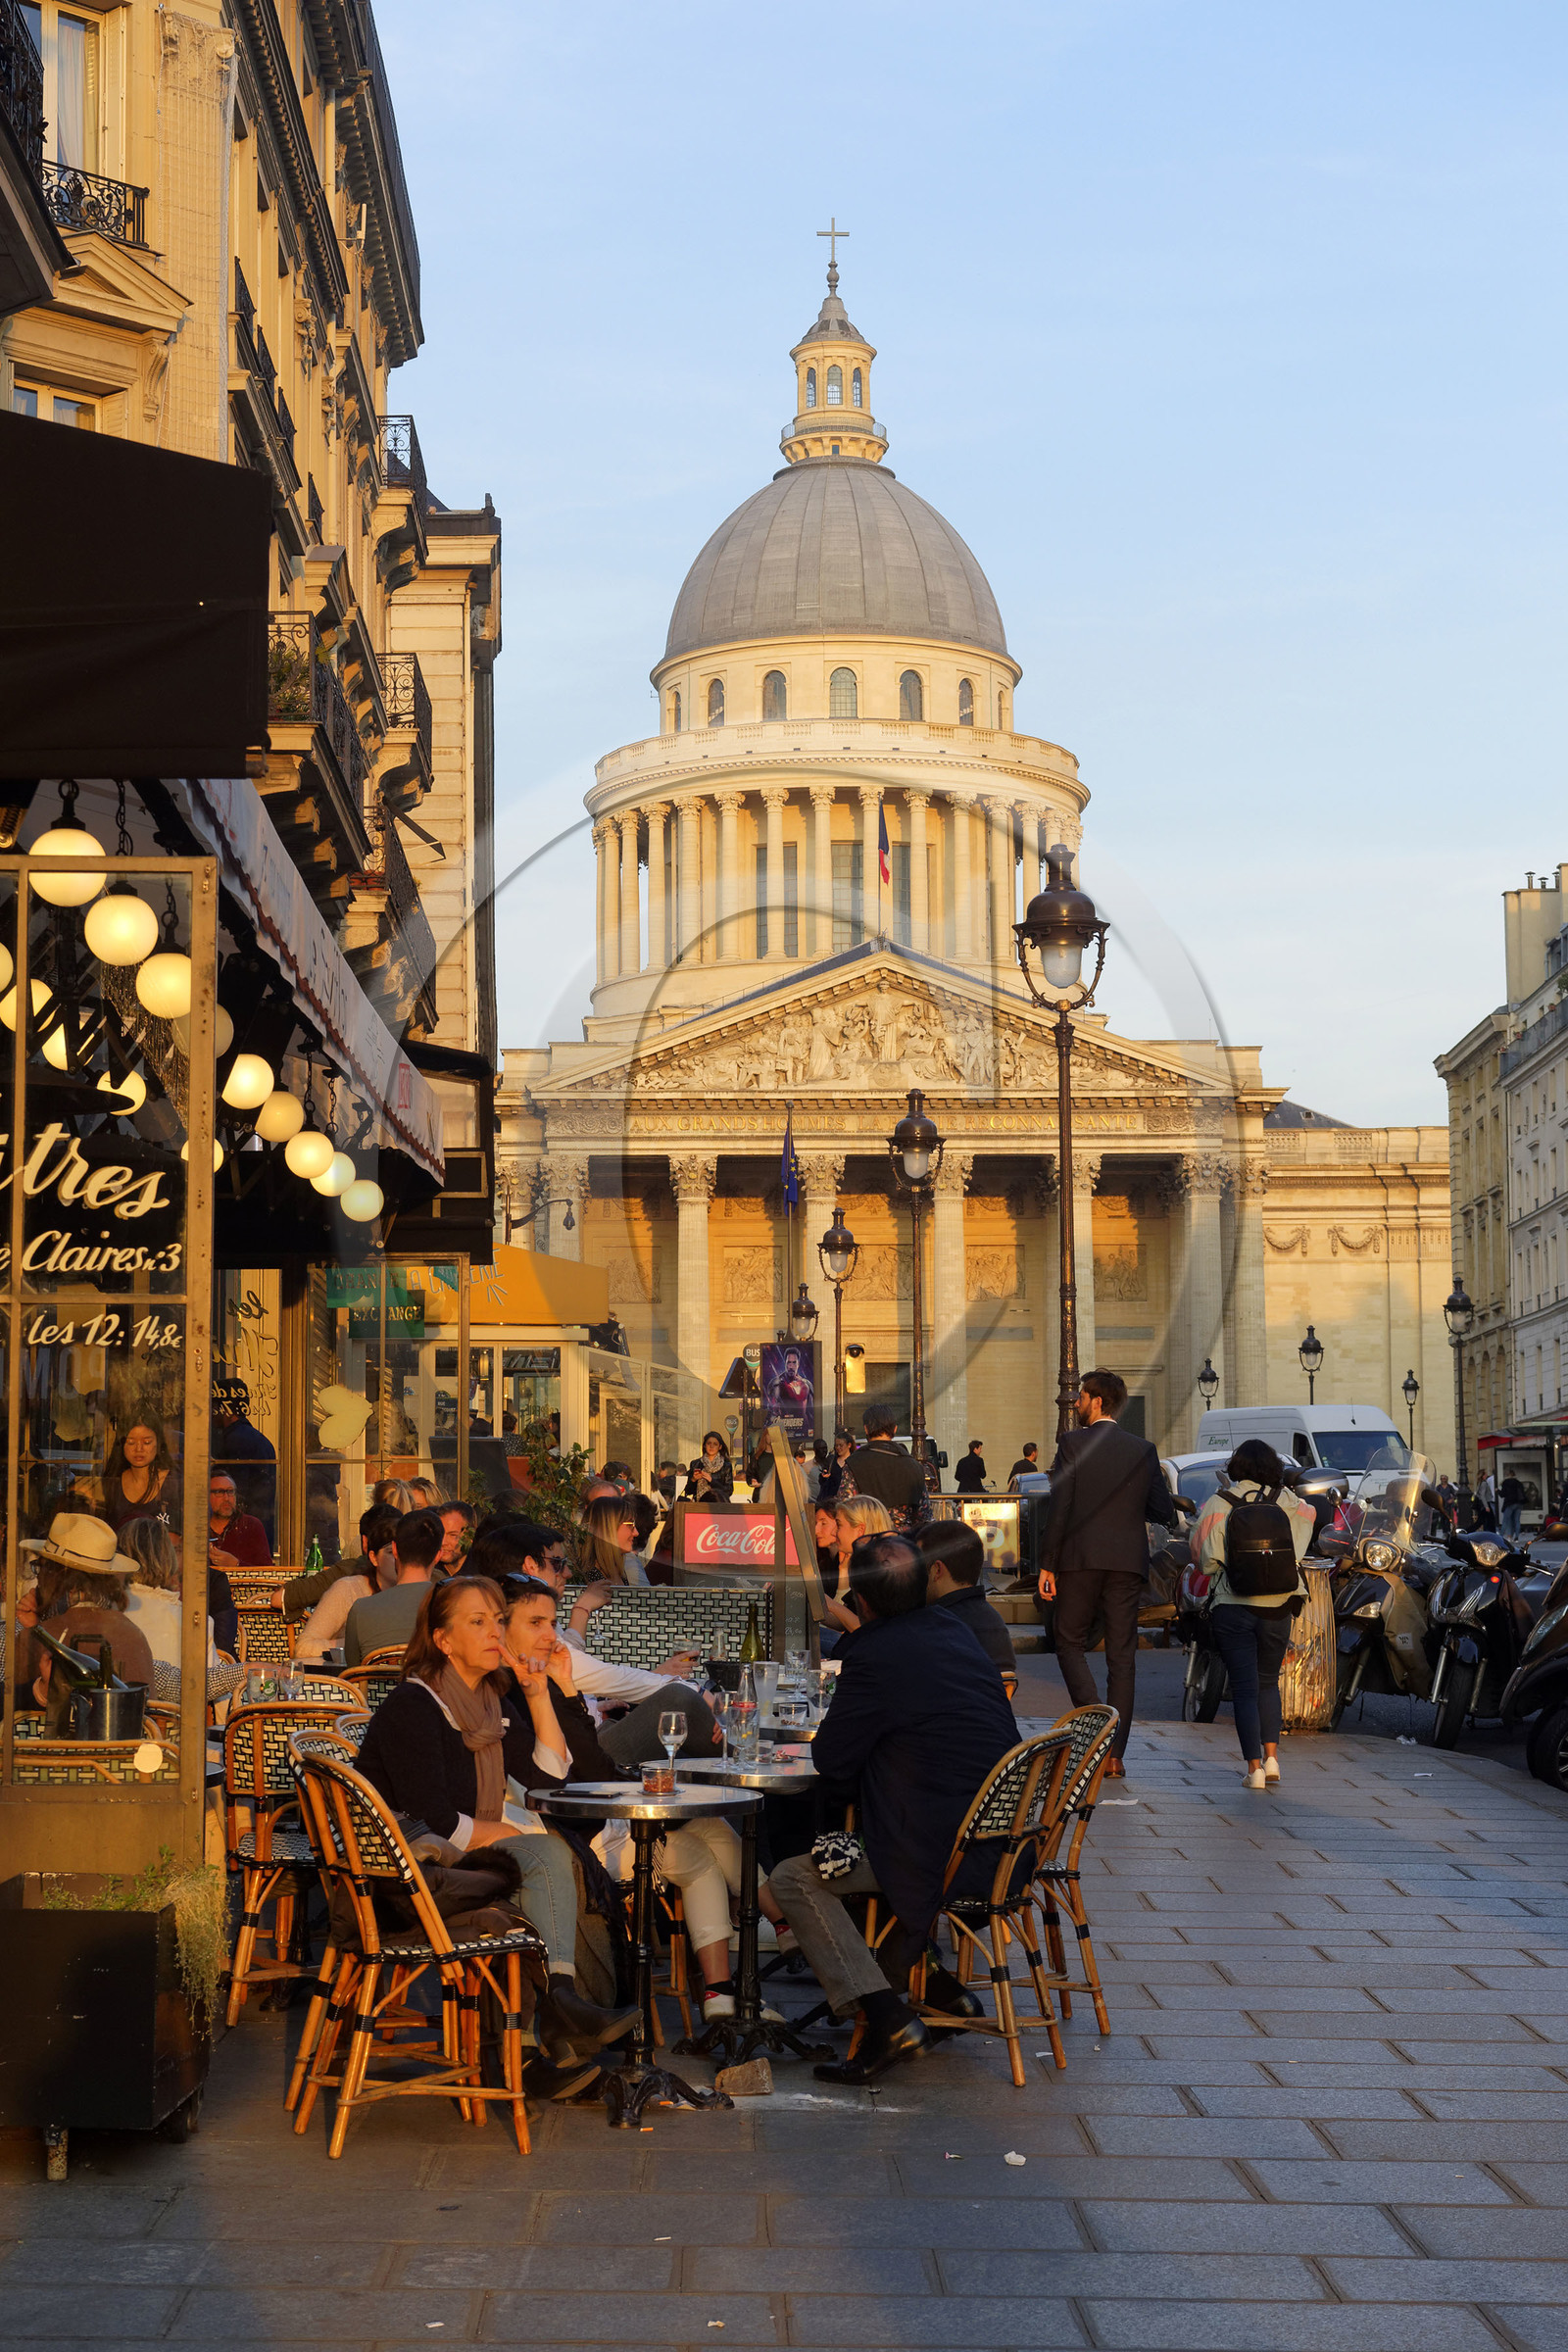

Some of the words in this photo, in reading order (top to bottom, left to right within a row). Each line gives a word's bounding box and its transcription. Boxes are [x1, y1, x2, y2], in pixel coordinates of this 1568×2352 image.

[631, 1115, 671, 1131] AUX
[678, 1115, 758, 1131] GRANDS
[763, 1115, 846, 1131] HOMMES
[858, 1115, 882, 1130] LA
[964, 1114, 1138, 1130] RECONNASANTE
[22, 1229, 149, 1273] Claires
[354, 1305, 421, 1322] EXCANGE
[27, 1310, 75, 1347] les
[80, 1313, 126, 1348] 12:
[745, 1348, 760, 1357] BUS
